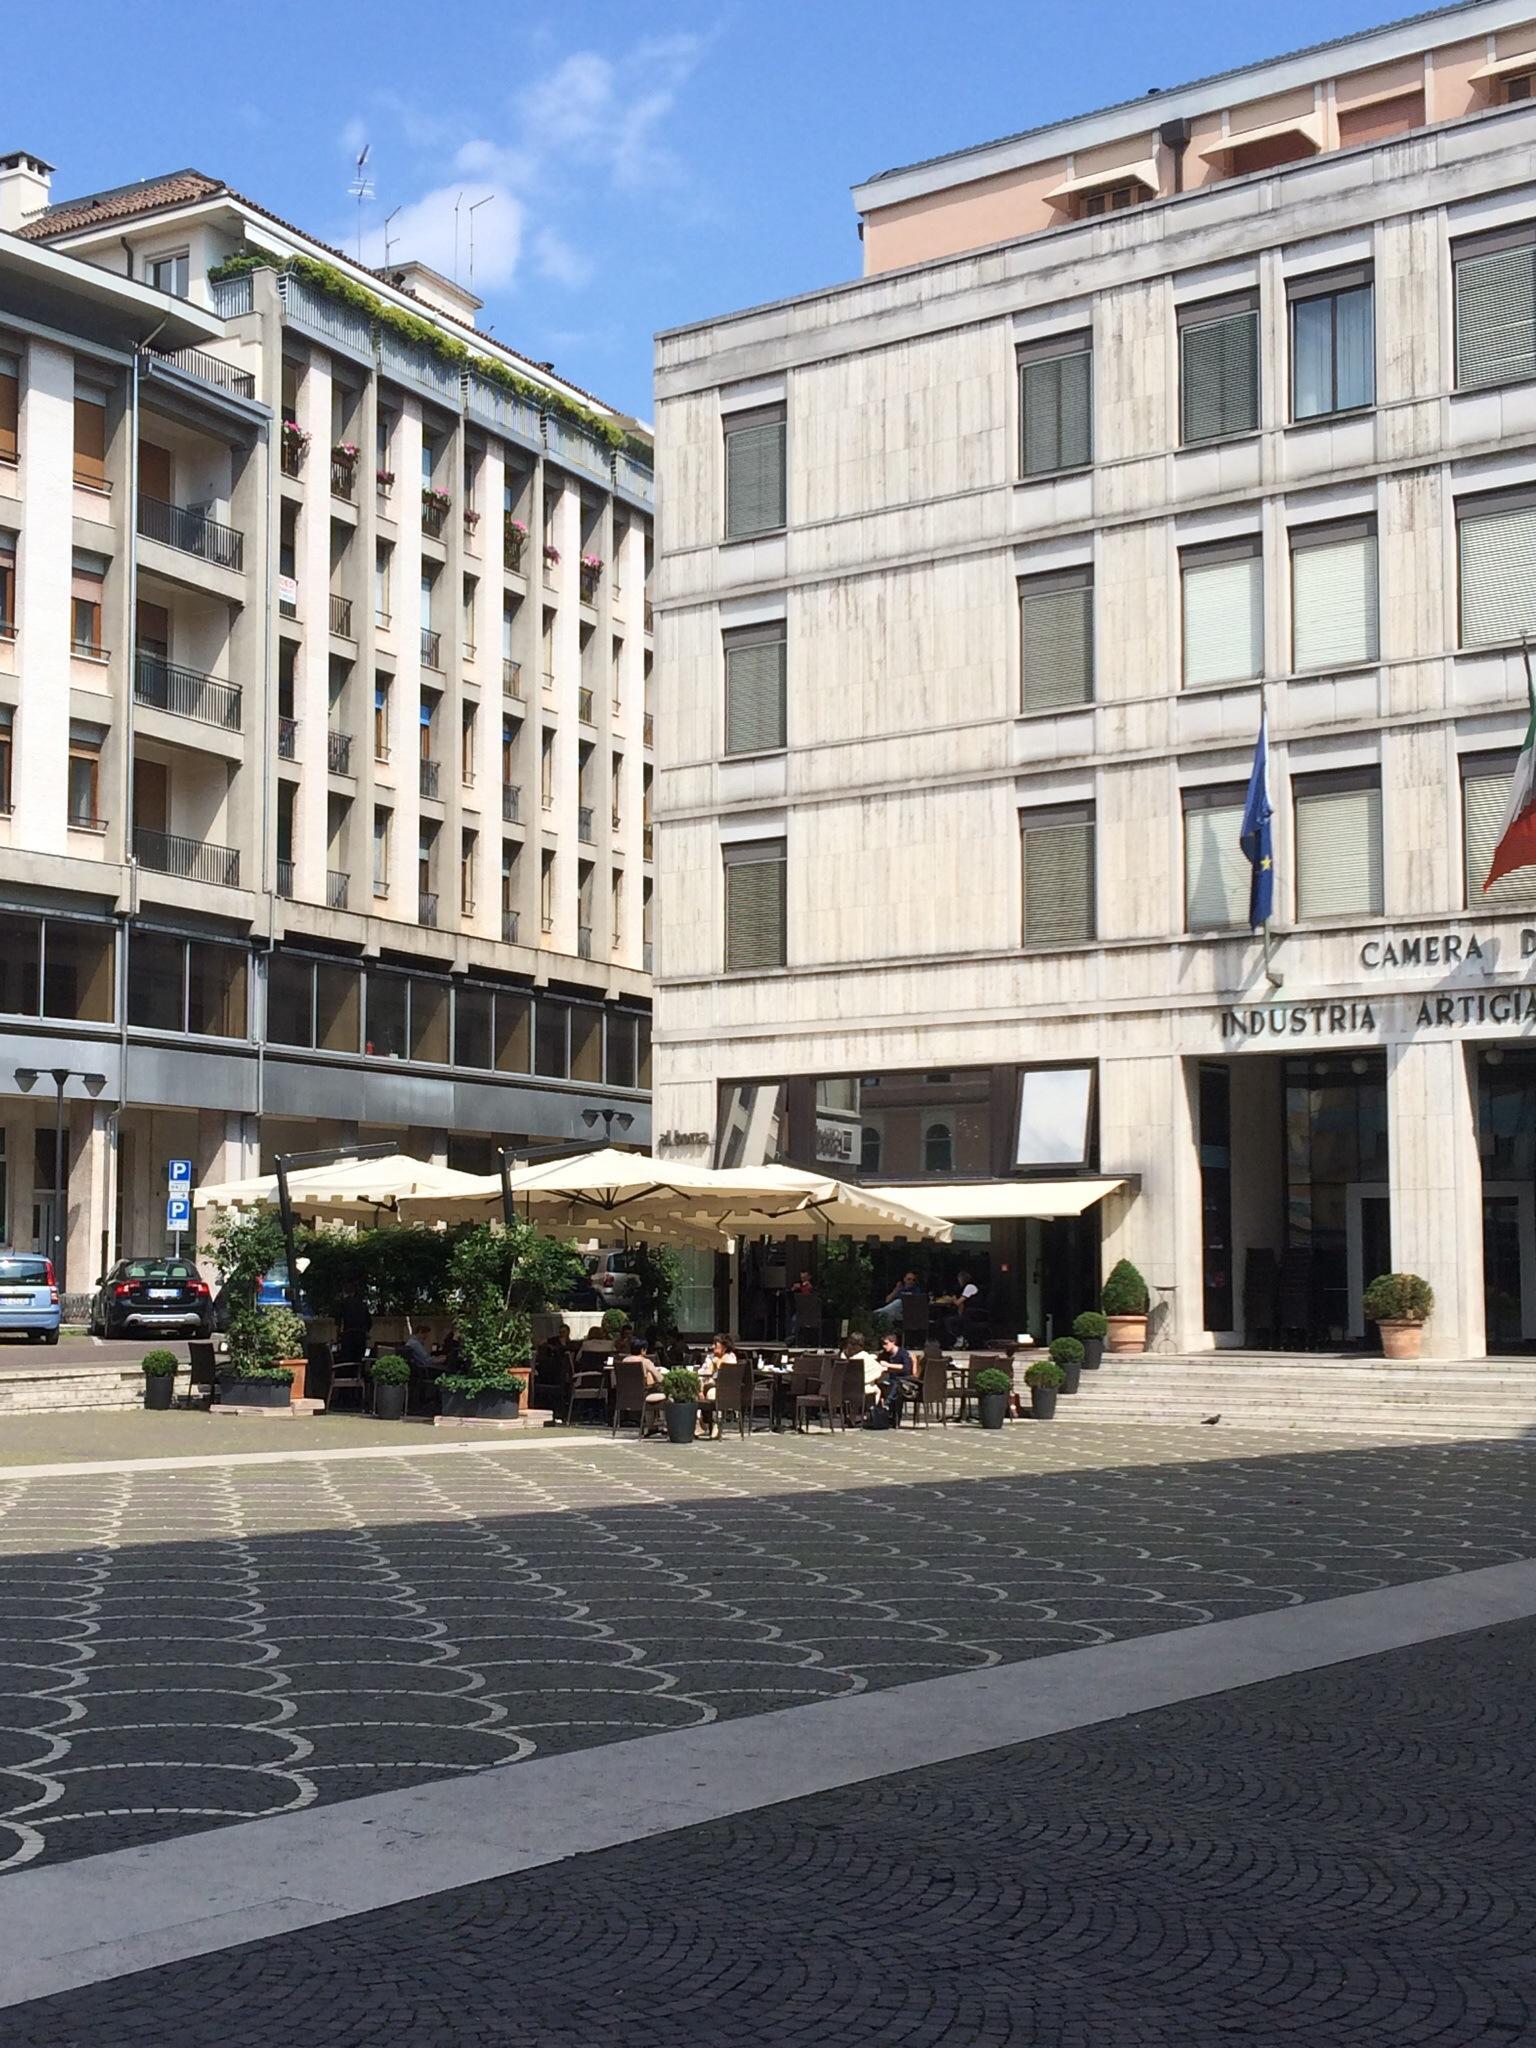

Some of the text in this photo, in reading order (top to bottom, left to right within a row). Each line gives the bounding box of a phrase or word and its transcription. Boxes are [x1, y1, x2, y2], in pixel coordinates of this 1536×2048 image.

[1361, 933, 1483, 968] CAMERA
[1221, 1003, 1375, 1037] INDUSTRIA
[173, 1163, 186, 1179] P
[172, 1202, 185, 1218] P
